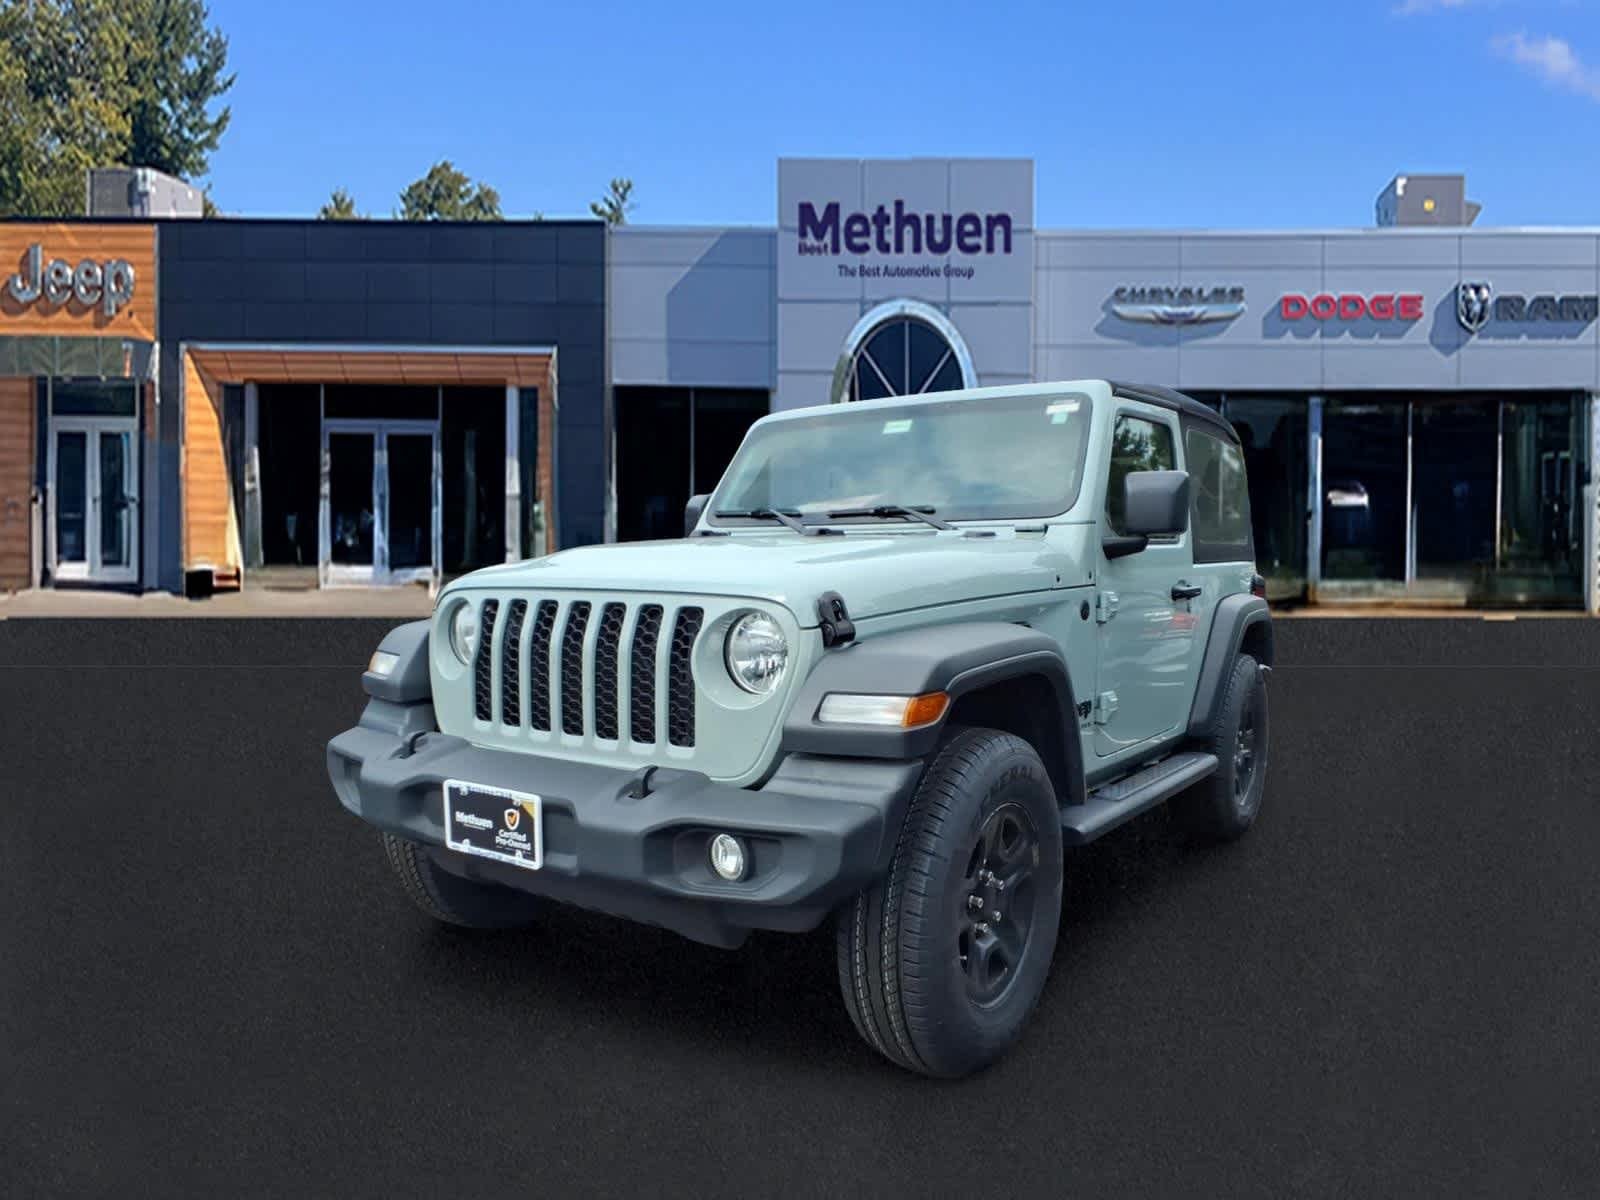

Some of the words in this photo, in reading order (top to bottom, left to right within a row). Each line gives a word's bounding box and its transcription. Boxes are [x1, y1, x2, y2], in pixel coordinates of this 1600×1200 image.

[798, 199, 1012, 255] Methuen
[798, 241, 829, 255] Best
[8, 243, 135, 316] Jeep
[838, 264, 857, 278] The
[859, 264, 881, 278] Best
[883, 264, 940, 278] Automotive
[943, 264, 975, 280] Group
[1113, 286, 1245, 304] CHRYSLER
[1280, 294, 1424, 321] DODGE
[1494, 295, 1599, 321] RAM
